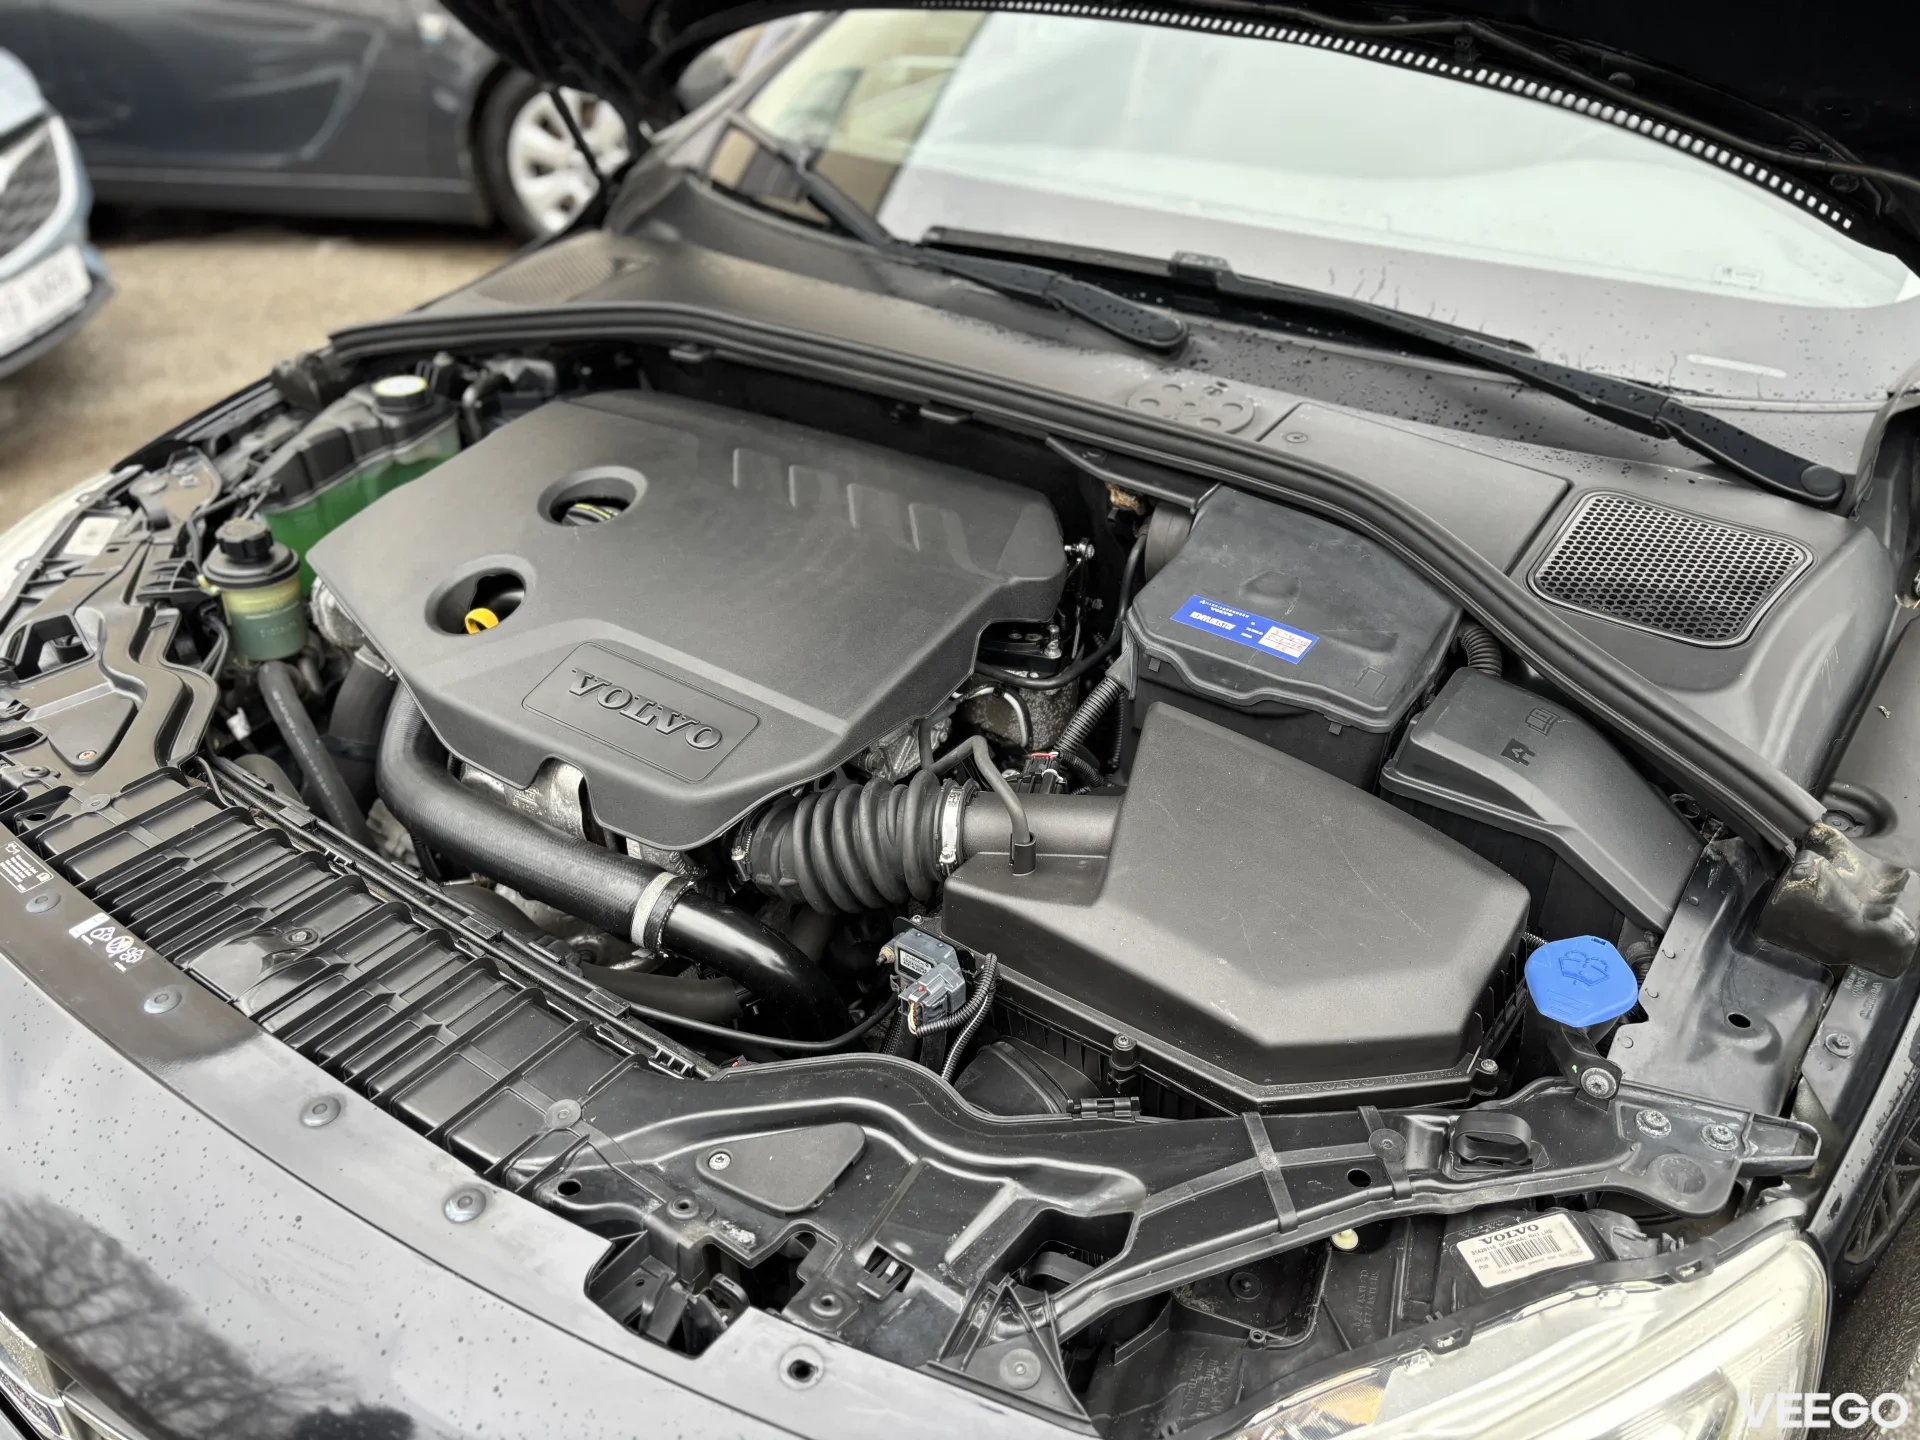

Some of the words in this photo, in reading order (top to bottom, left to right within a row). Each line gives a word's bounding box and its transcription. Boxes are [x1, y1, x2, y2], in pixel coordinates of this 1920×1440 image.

[569, 667, 723, 750] VOLVO
[1305, 1078, 1375, 1092] VOLVO
[1479, 1224, 1540, 1245] VOLVO
